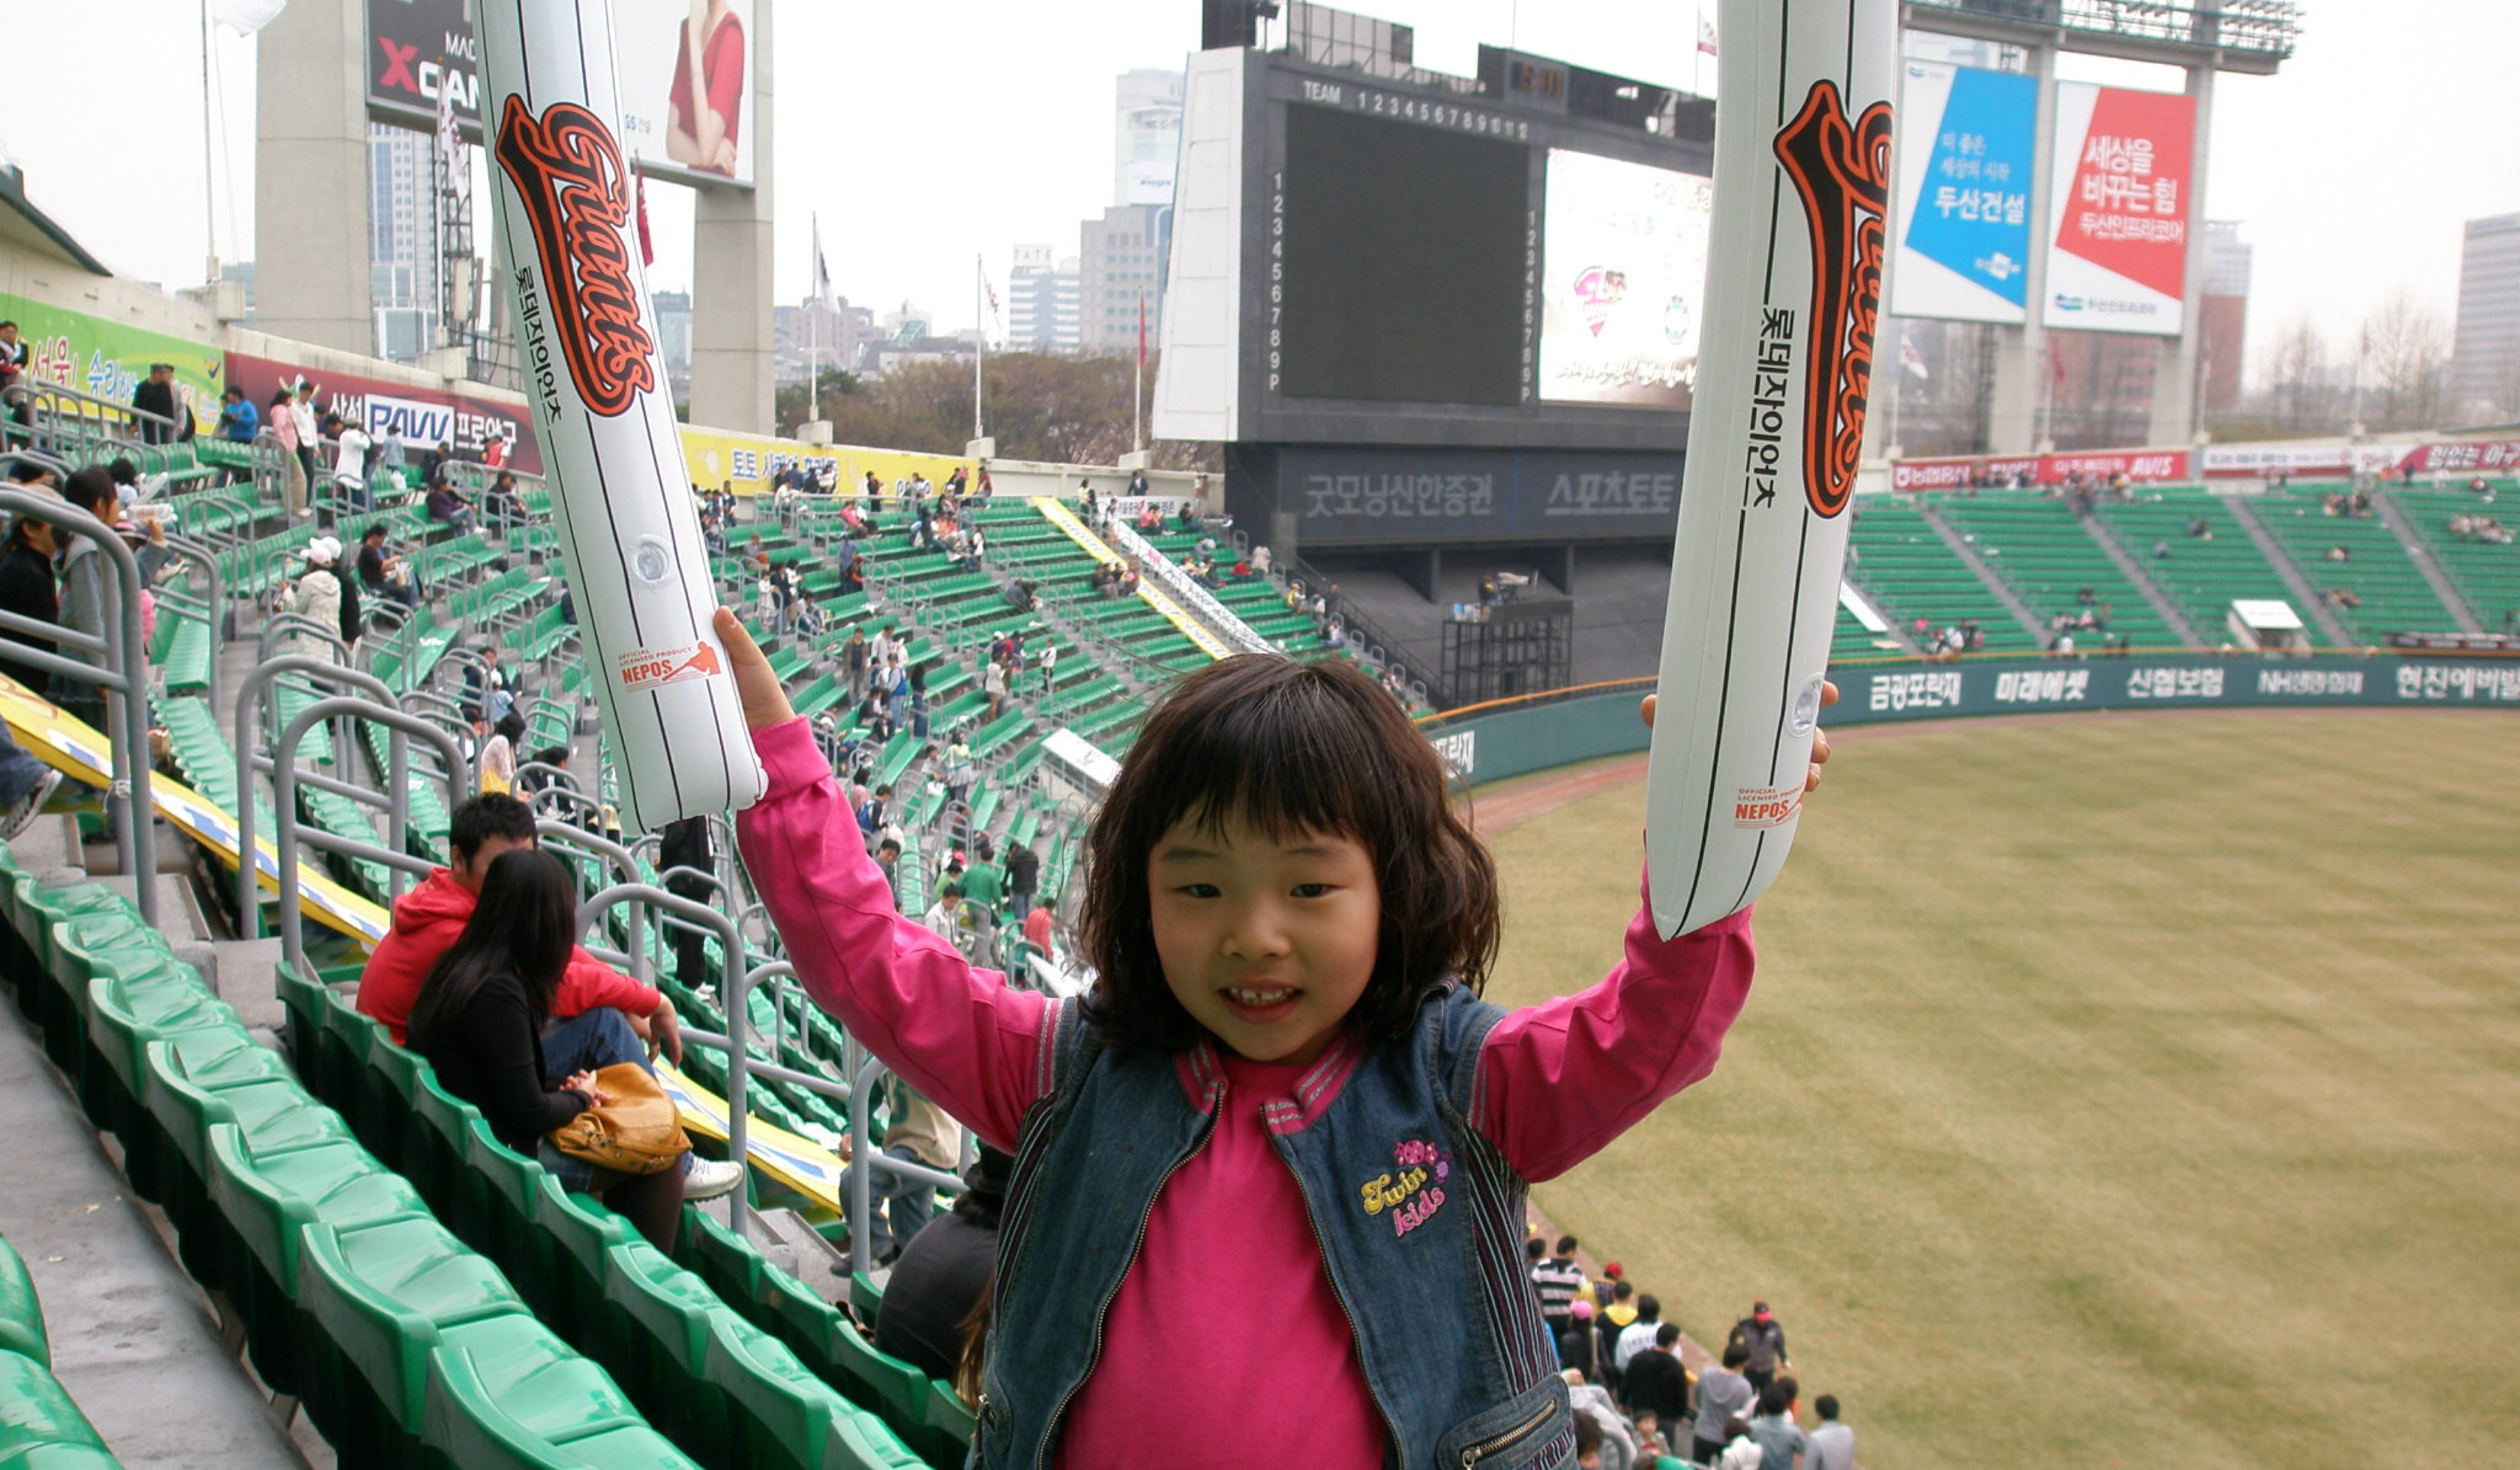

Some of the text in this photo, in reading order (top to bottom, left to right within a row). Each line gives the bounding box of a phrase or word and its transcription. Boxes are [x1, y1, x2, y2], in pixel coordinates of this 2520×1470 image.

[1304, 80, 1340, 103] TEAM
[1358, 91, 1366, 108] 1
[1375, 94, 1382, 111] 2
[1391, 97, 1398, 115] 3
[1405, 101, 1413, 117] 4
[1421, 103, 1428, 120] 5
[1435, 106, 1443, 123] 6
[1450, 108, 1458, 125] 7
[1464, 112, 1472, 128] 8
[1478, 114, 1486, 131] 9
[2085, 136, 2155, 175] 세상을
[1935, 186, 2025, 225] 두산건설
[2082, 173, 2177, 215] 바꾸는 힘
[501, 93, 654, 416] Giants
[1270, 173, 1283, 390] 1 2 3 4 5 6 7 8 9 P
[515, 265, 561, 424] 롯데자이언츠
[370, 403, 450, 441] PAVV
[456, 413, 517, 450] 프로야구
[1754, 308, 1795, 509] 롯데자이언츠
[2129, 456, 2174, 476] AVIS
[1306, 473, 1495, 518] 굿모닝신한증권
[1545, 471, 1675, 516] 스포츠토토
[618, 649, 649, 660] OFFICIAL
[620, 648, 691, 665] LICENSED PRODUCT
[622, 659, 672, 683] NEPOS
[1870, 672, 1961, 711] 금광포란재
[1995, 669, 2090, 702] 미래에셋
[1735, 799, 1789, 819] NEPOS
